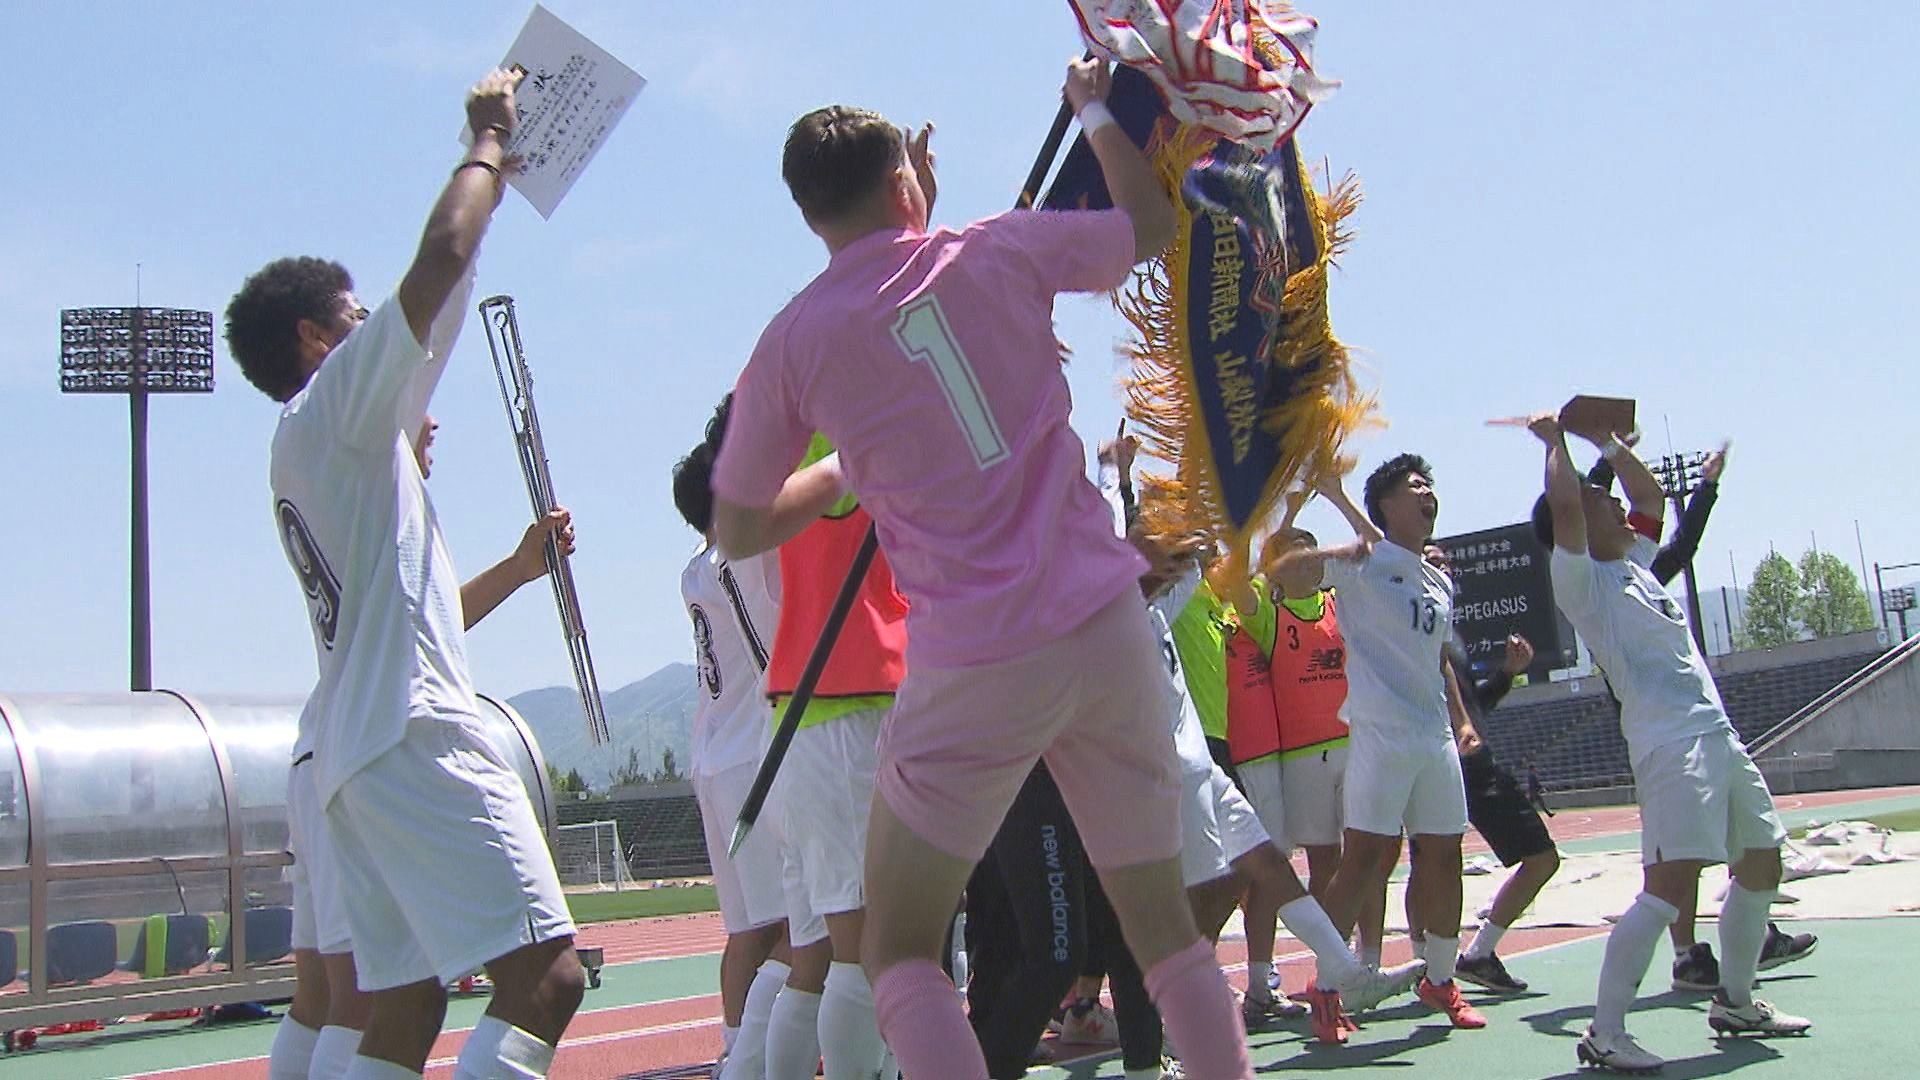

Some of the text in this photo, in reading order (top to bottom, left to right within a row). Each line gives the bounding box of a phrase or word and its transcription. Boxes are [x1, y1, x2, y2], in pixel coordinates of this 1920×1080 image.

[889, 293, 1011, 471] 1
[277, 499, 343, 650] 9
[1287, 624, 1300, 650] 3
[1408, 599, 1436, 635] 13
[1041, 825, 1070, 961] new balance
